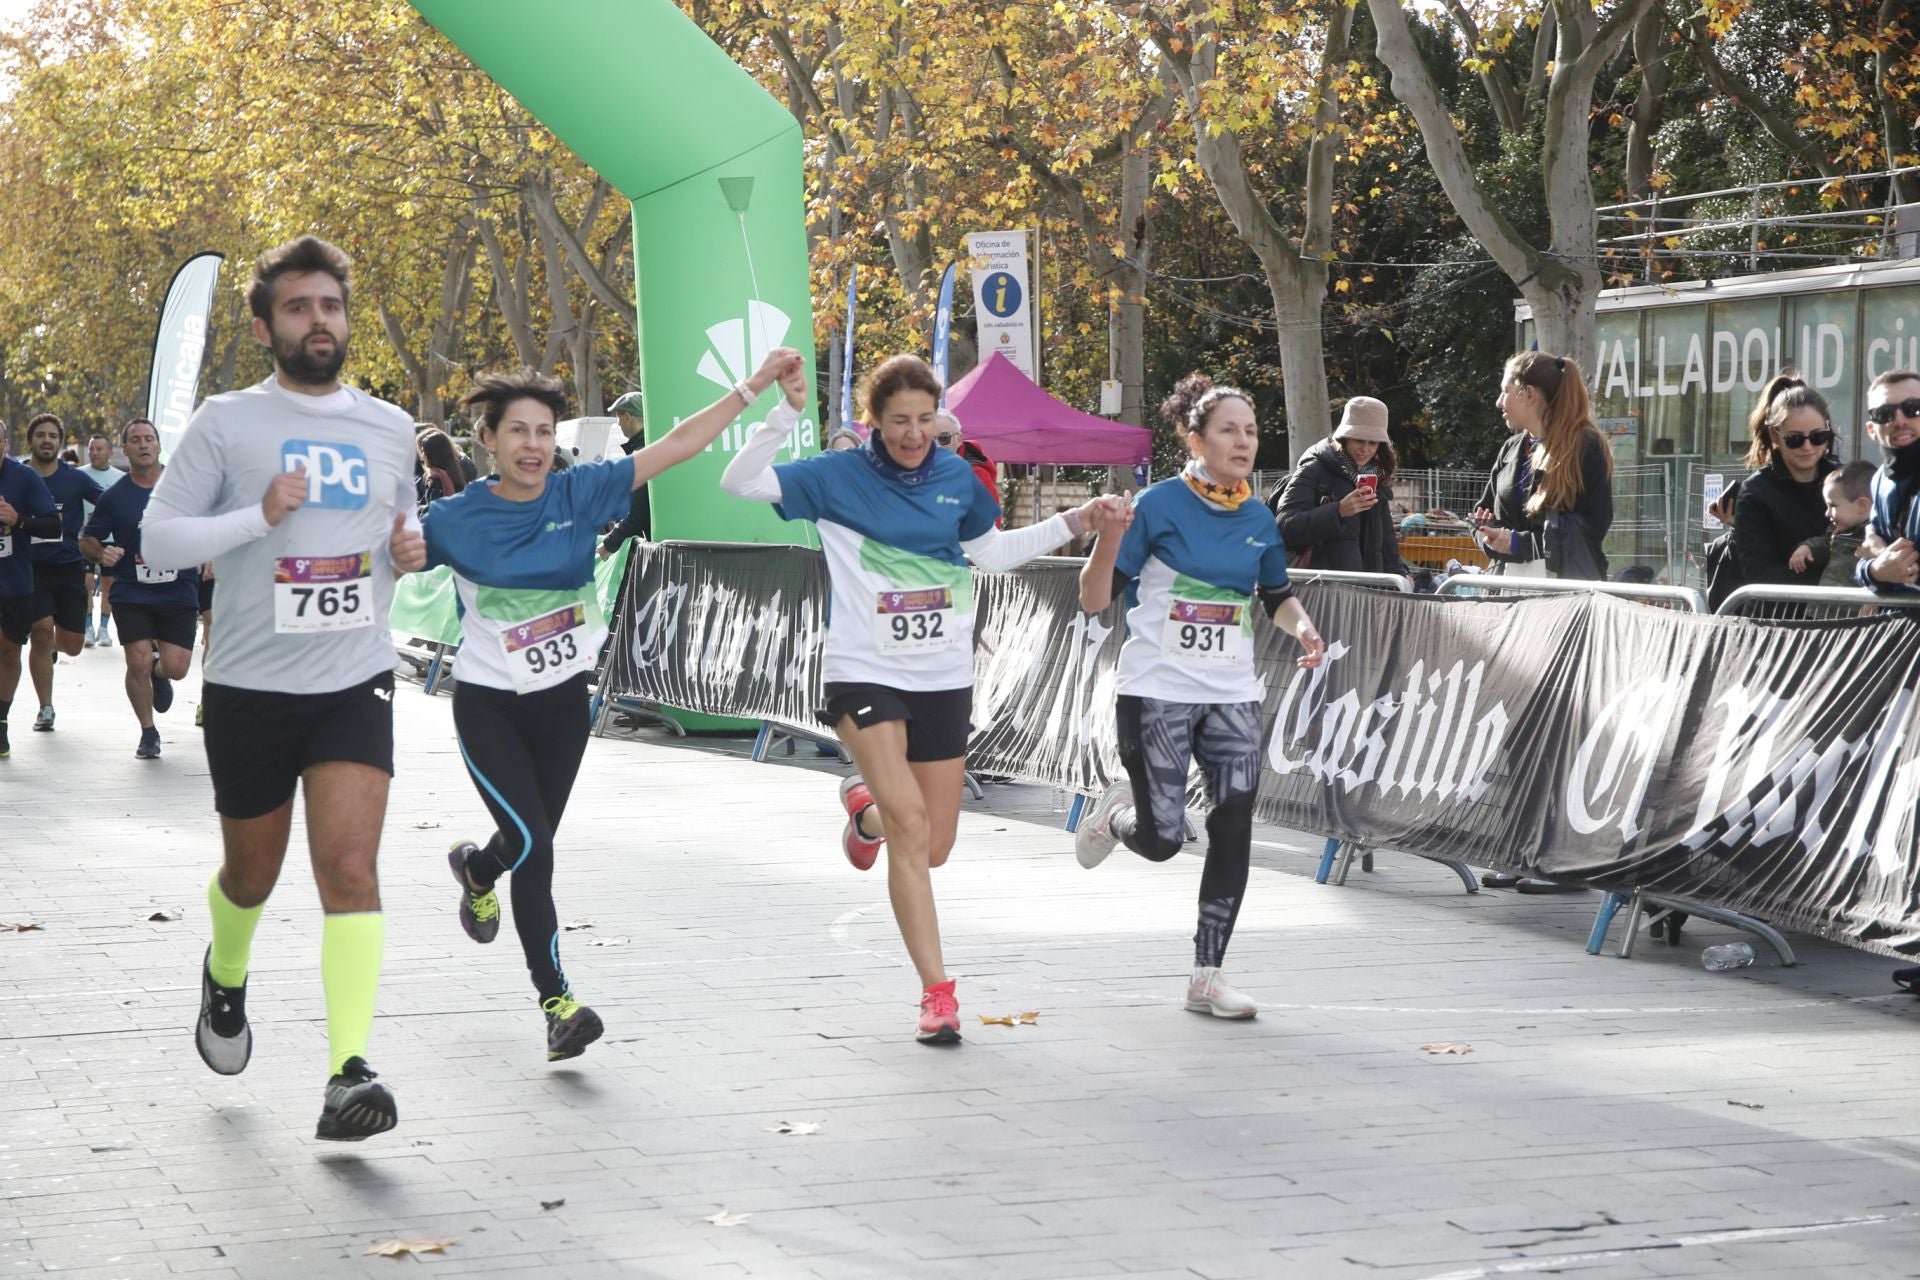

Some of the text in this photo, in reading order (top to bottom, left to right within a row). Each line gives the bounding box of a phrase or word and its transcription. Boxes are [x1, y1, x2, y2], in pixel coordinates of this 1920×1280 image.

[975, 241, 999, 249] Oficina
[159, 313, 207, 435] Unicaja
[290, 583, 360, 617] 765
[891, 611, 944, 641] 932
[1180, 624, 1226, 652] 931
[525, 632, 577, 674] 933
[1268, 640, 1510, 807] Castilla
